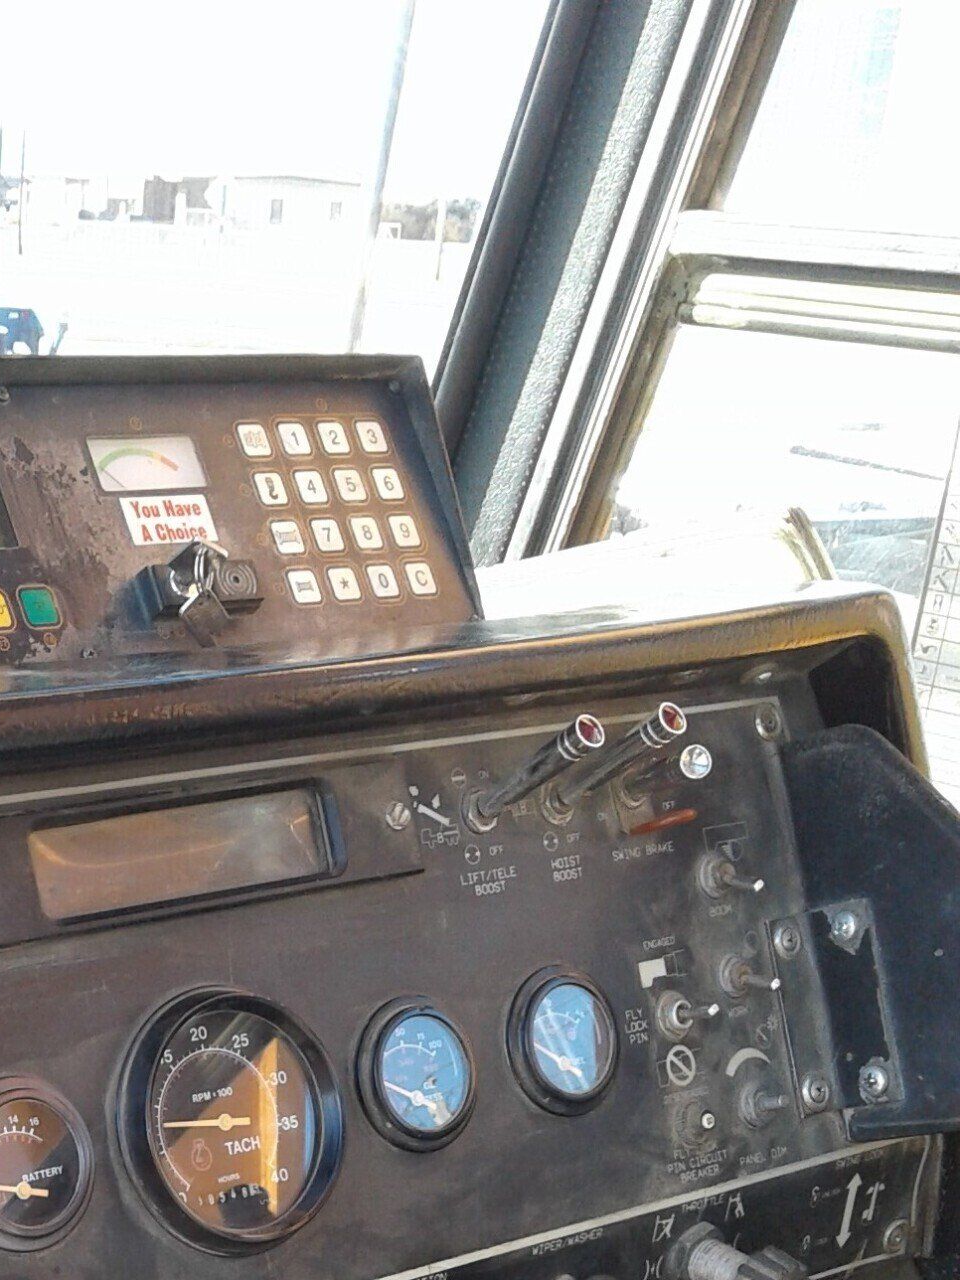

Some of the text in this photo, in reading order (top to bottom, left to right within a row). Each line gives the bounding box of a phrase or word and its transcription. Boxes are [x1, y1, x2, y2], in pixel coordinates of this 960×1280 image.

[291, 429, 378, 446] 1 2 3
[307, 475, 394, 494] 4 5 6
[129, 500, 201, 519] You Have
[140, 523, 207, 542] A Choice
[322, 523, 410, 542] 7 8 9
[378, 570, 428, 589] 0 C
[567, 833, 580, 843] OFF
[490, 845, 503, 856] OFF
[611, 841, 675, 861] SWING BRAKE
[551, 855, 580, 869] HOIST
[460, 866, 517, 886] LIFT/TELE
[553, 868, 582, 882] BOOST
[475, 881, 506, 896] BOOST
[642, 936, 675, 951] ENGAGED
[625, 1008, 643, 1021] FLY
[190, 1026, 207, 1041] 20
[625, 1020, 648, 1034] LOCK
[233, 1033, 249, 1048] 25
[629, 1032, 648, 1045] PIN
[269, 1070, 287, 1085] 30
[192, 1091, 211, 1102] RPM
[217, 1086, 233, 1099] 100
[7, 1114, 19, 1124] 14
[29, 1116, 39, 1126] 16
[281, 1115, 298, 1130] 35
[224, 1135, 261, 1155] TACH
[667, 1150, 727, 1174] PIN CIRCUIT
[740, 1147, 787, 1165] PANEL DIM
[22, 1165, 63, 1183] BATTERY
[271, 1168, 288, 1183] 40
[681, 1164, 720, 1183] BREAKER
[532, 1228, 604, 1255] WIPER/WASHER
